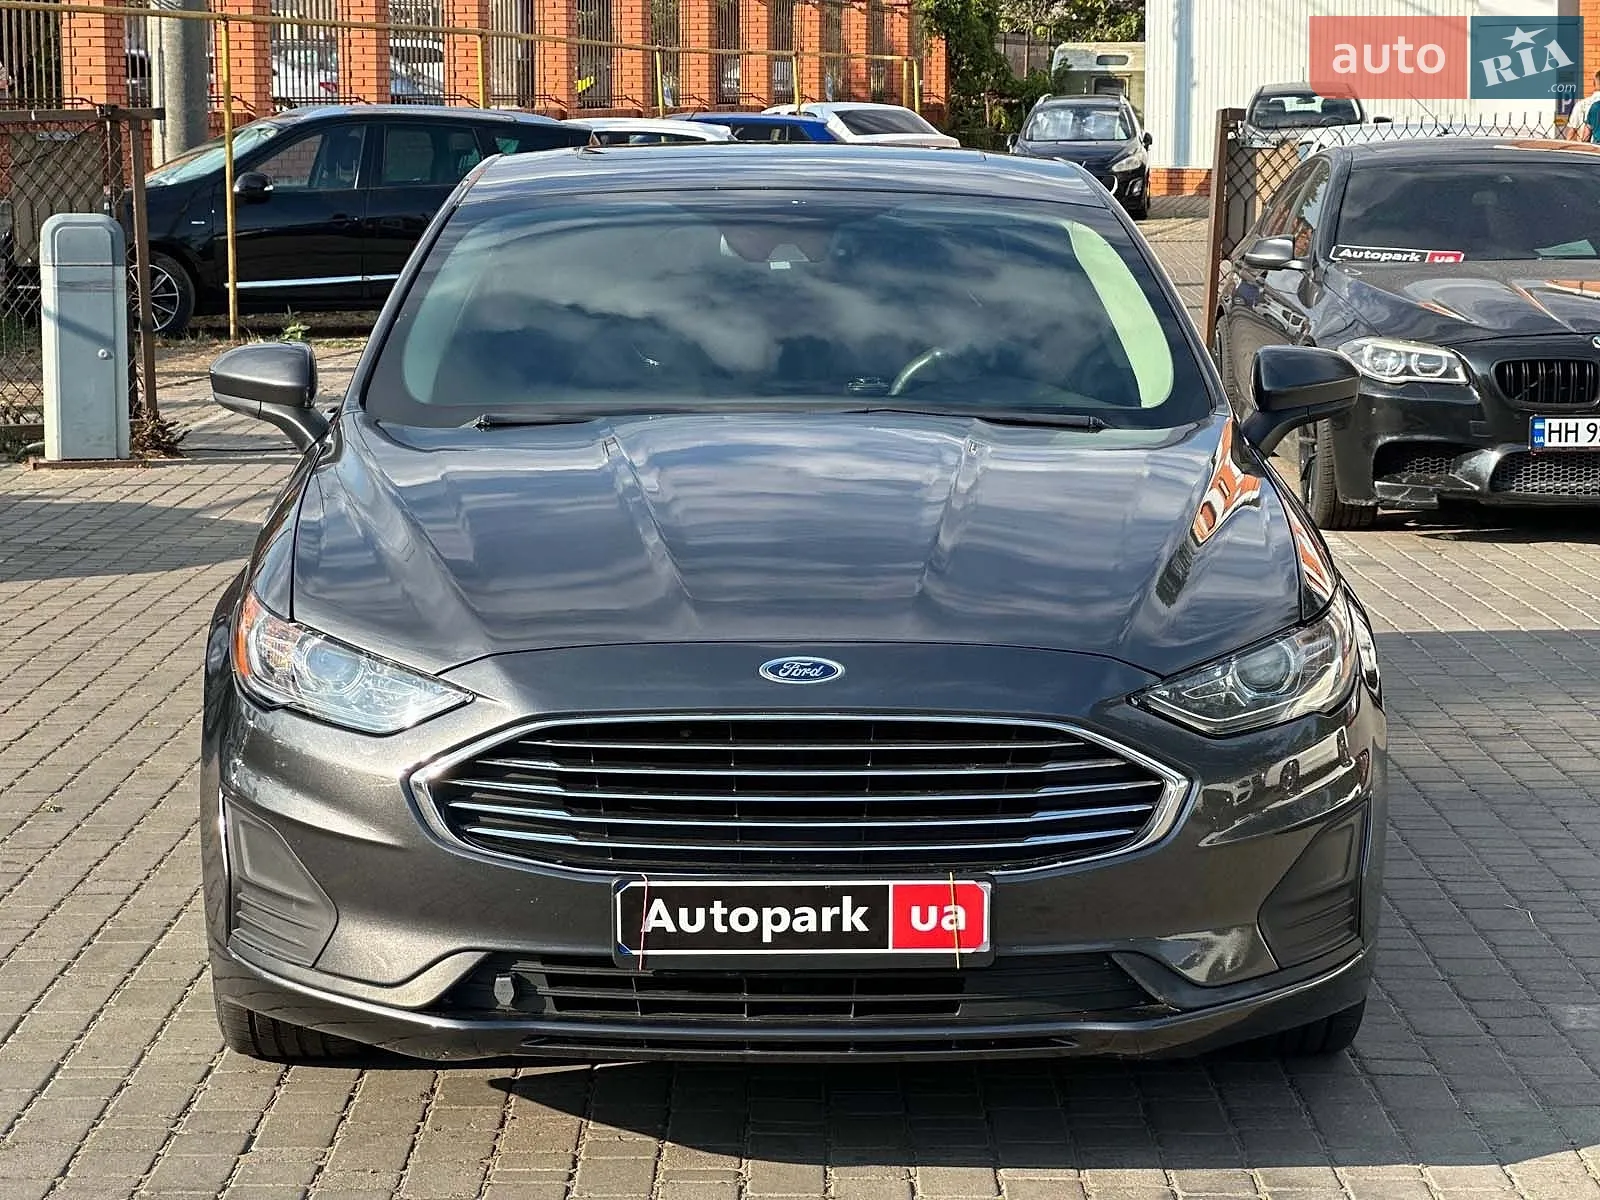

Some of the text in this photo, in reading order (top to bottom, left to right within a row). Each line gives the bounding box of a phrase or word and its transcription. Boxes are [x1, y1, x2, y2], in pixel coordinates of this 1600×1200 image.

[1339, 248, 1456, 263] Autopark ua
[1548, 422, 1600, 443] HH 9
[778, 661, 825, 677] Ford
[641, 896, 967, 943] Autopark ua
